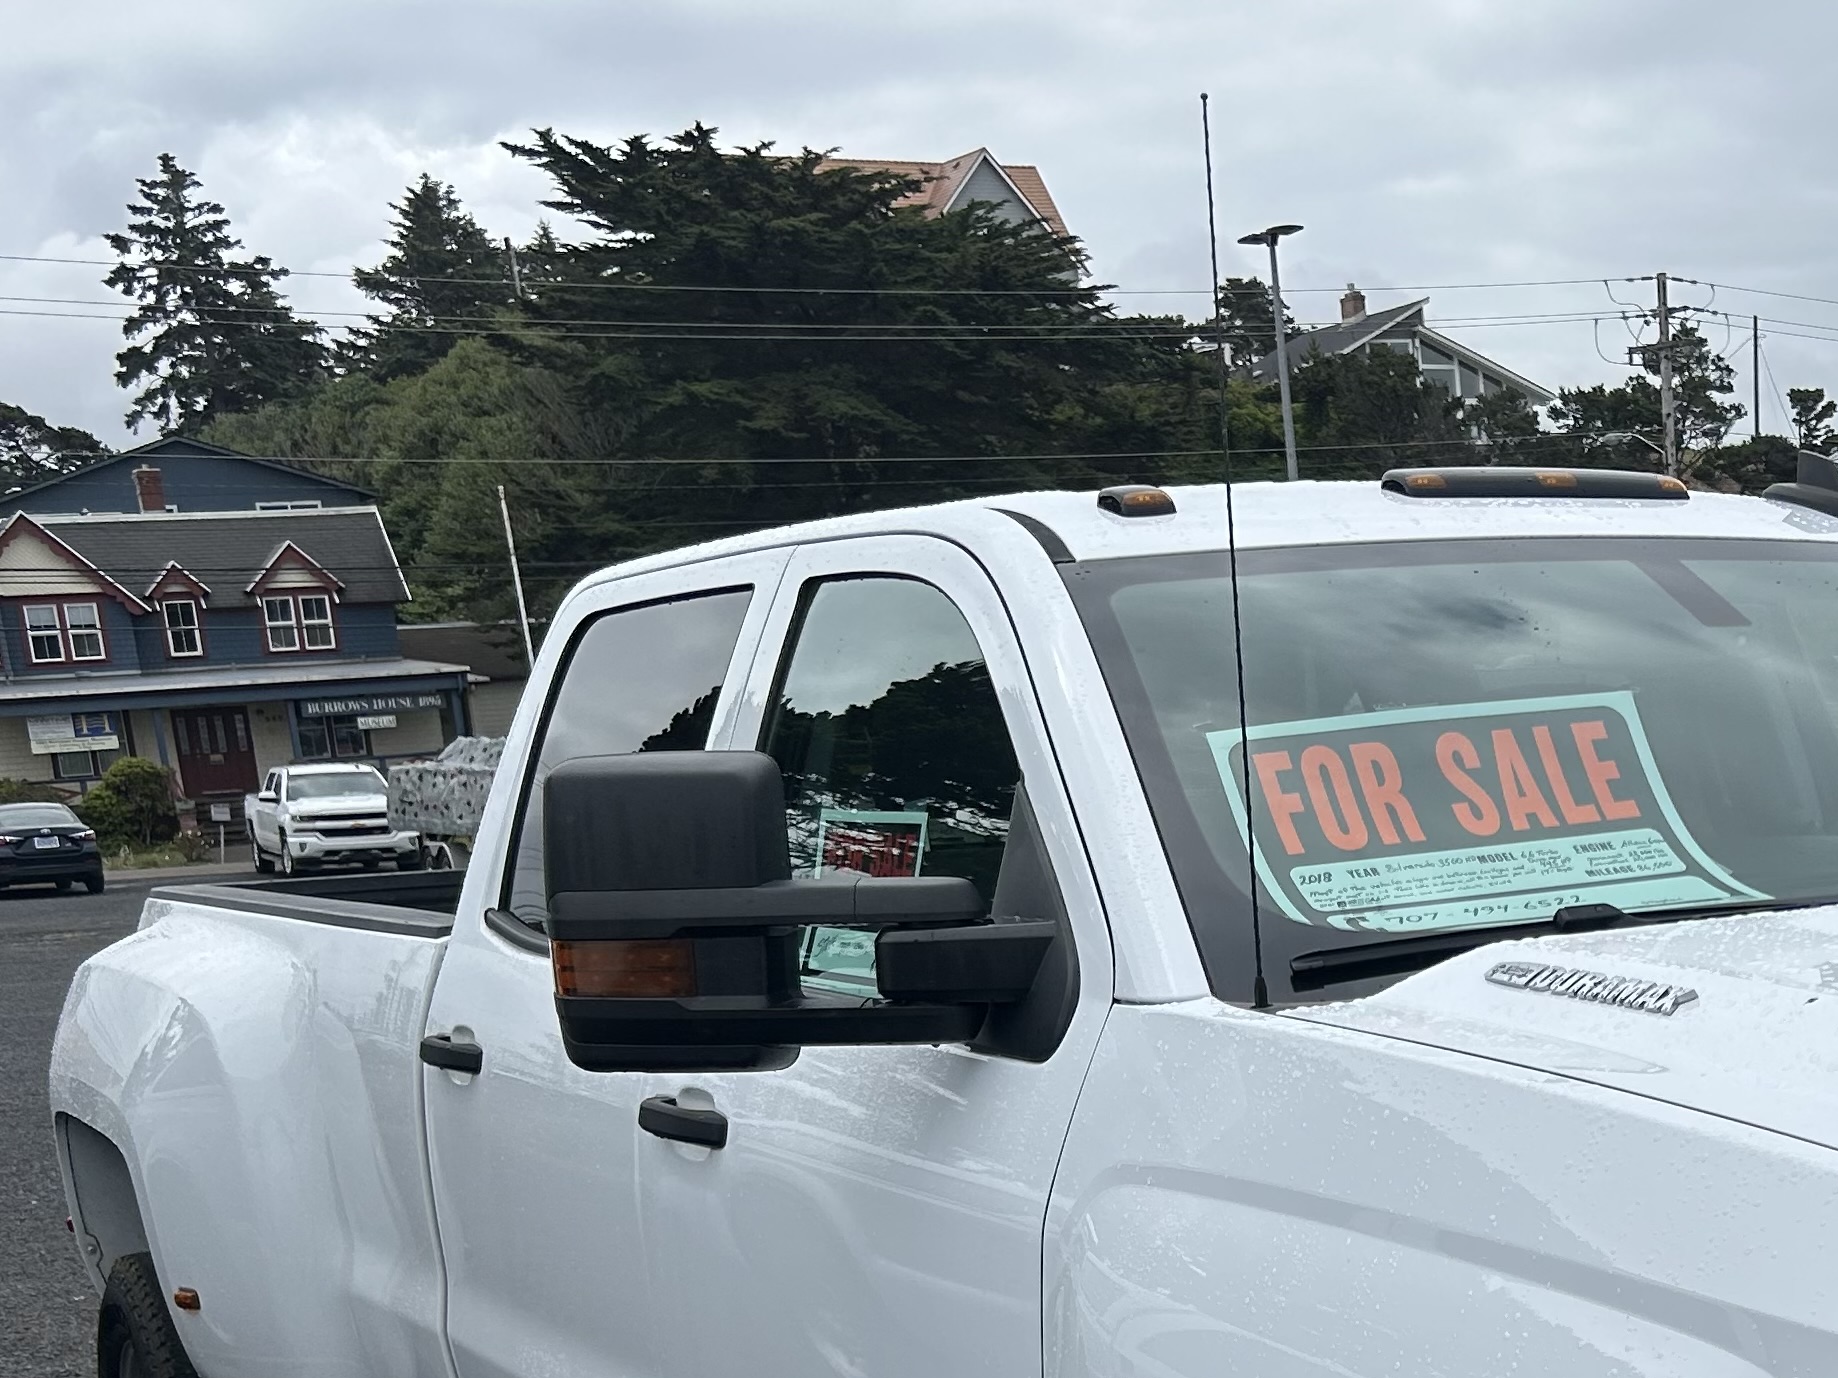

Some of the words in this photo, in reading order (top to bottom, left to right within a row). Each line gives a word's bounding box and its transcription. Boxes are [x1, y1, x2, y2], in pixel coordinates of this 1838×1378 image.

[307, 701, 369, 714] BURROWS
[373, 697, 414, 711] HOUSE
[1252, 741, 1428, 856] FOR
[1435, 720, 1642, 837] SALE
[1572, 840, 1617, 855] ENGINE
[1476, 851, 1519, 865] MODEL
[1298, 871, 1333, 886] 2018
[1345, 867, 1381, 879] YEAR
[1584, 864, 1637, 878] MILEAGE
[1528, 965, 1699, 1017] DURAMAX
